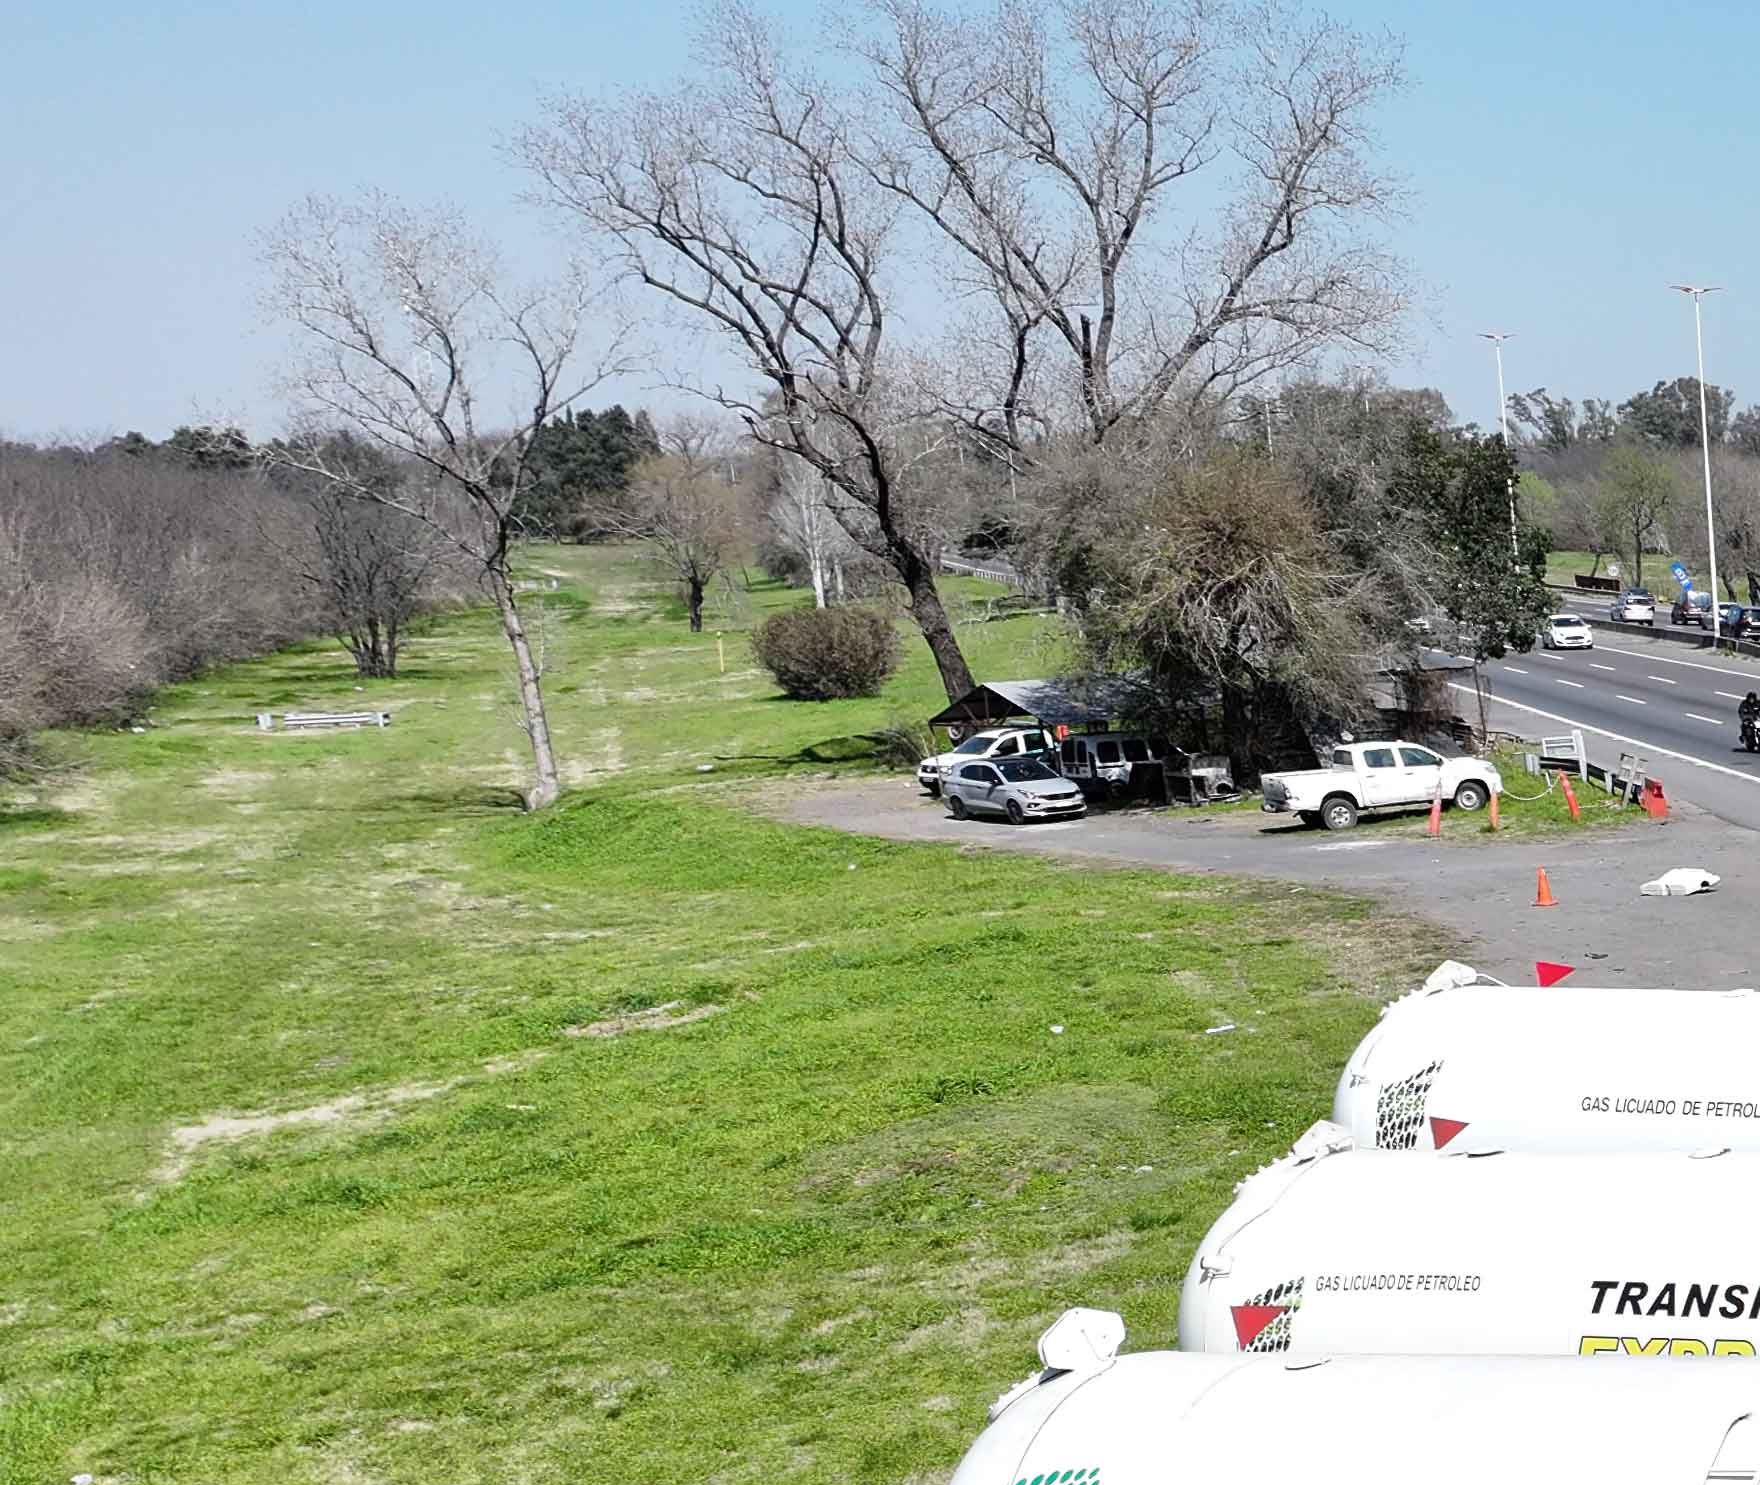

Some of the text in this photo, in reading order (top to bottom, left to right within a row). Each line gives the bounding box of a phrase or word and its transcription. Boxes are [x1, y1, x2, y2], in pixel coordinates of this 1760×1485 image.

[1582, 1097, 1609, 1113] GAS
[1615, 1098, 1676, 1115] LICUADO
[1682, 1101, 1702, 1116] DE
[1316, 1274, 1481, 1291] GAS LICUADO DE PETROLEO
